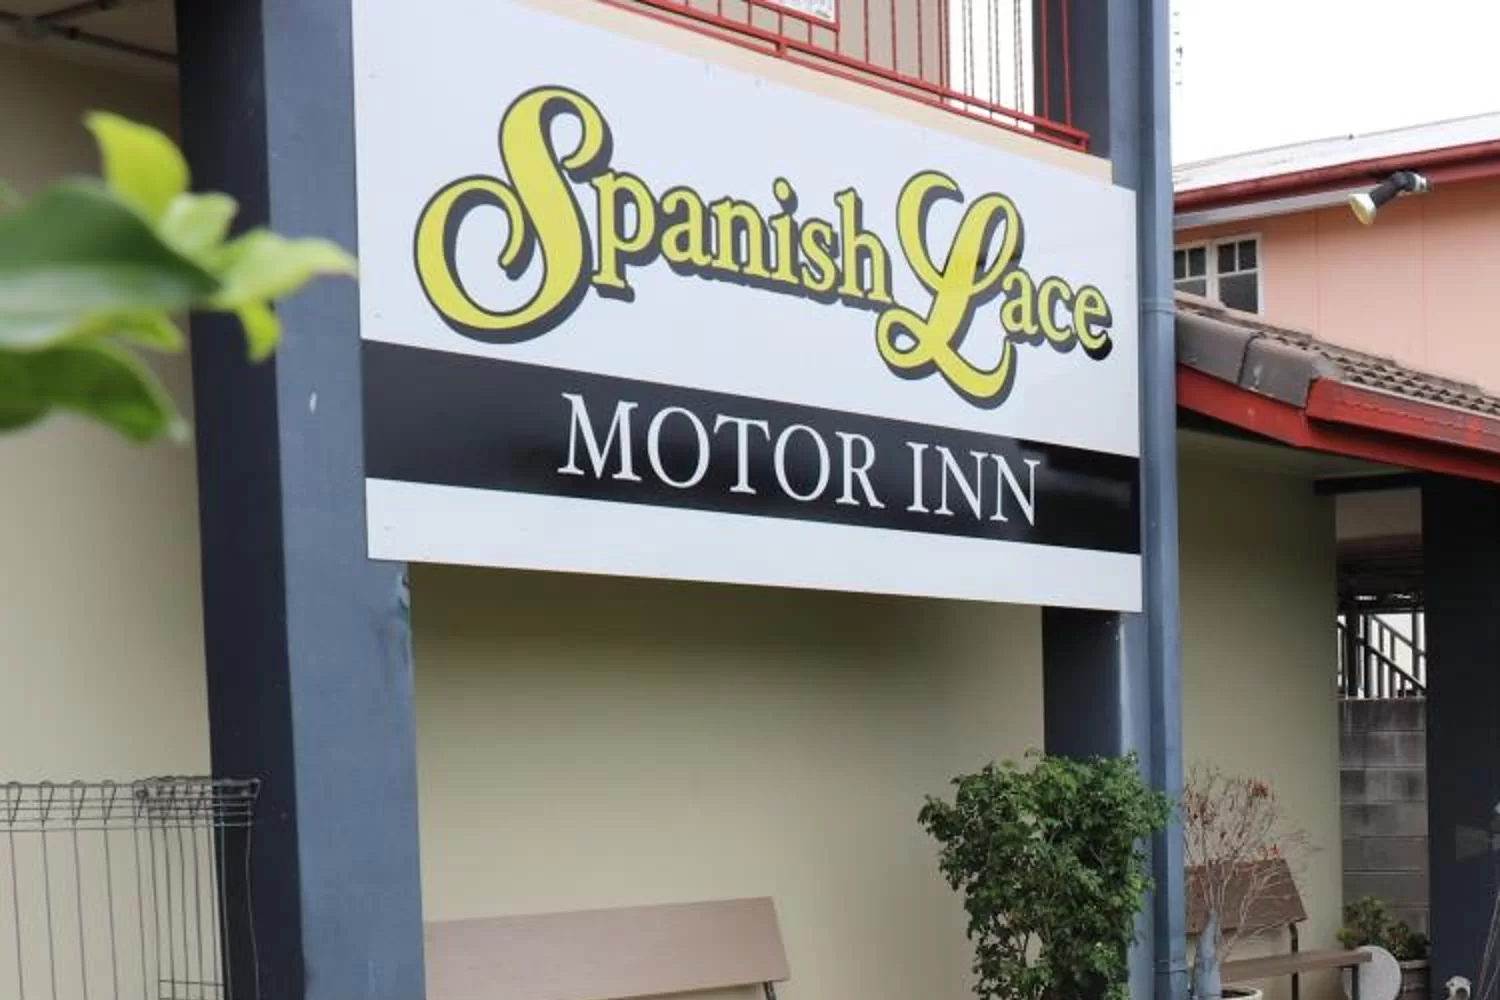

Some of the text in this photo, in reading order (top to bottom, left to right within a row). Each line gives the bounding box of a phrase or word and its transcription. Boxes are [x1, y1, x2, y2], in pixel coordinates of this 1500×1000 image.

[414, 85, 1112, 407] Spanish Lace
[558, 393, 1041, 527] MOTOR INN
